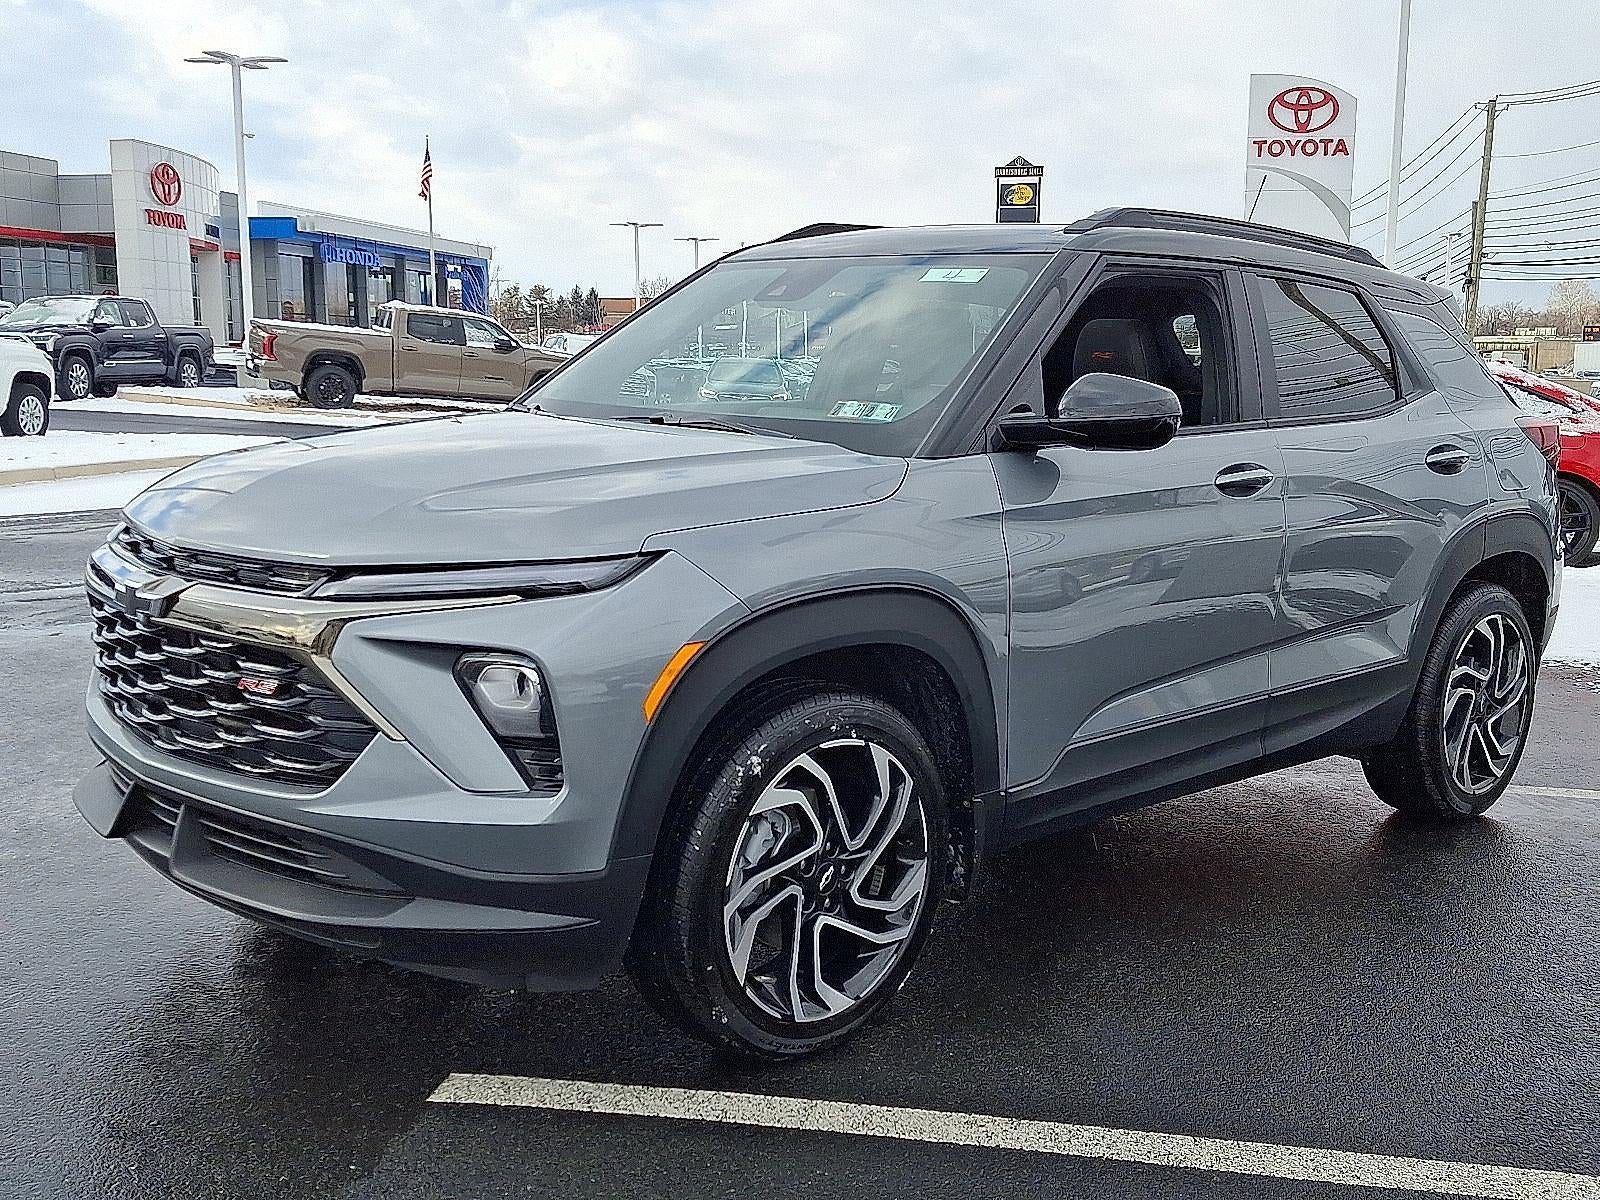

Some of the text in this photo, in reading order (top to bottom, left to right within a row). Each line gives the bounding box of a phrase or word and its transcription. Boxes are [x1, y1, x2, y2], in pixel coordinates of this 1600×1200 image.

[1253, 139, 1350, 157] TOYOTA
[145, 208, 187, 230] TOYOTA
[335, 247, 384, 267] HONDA
[237, 677, 278, 694] RS
